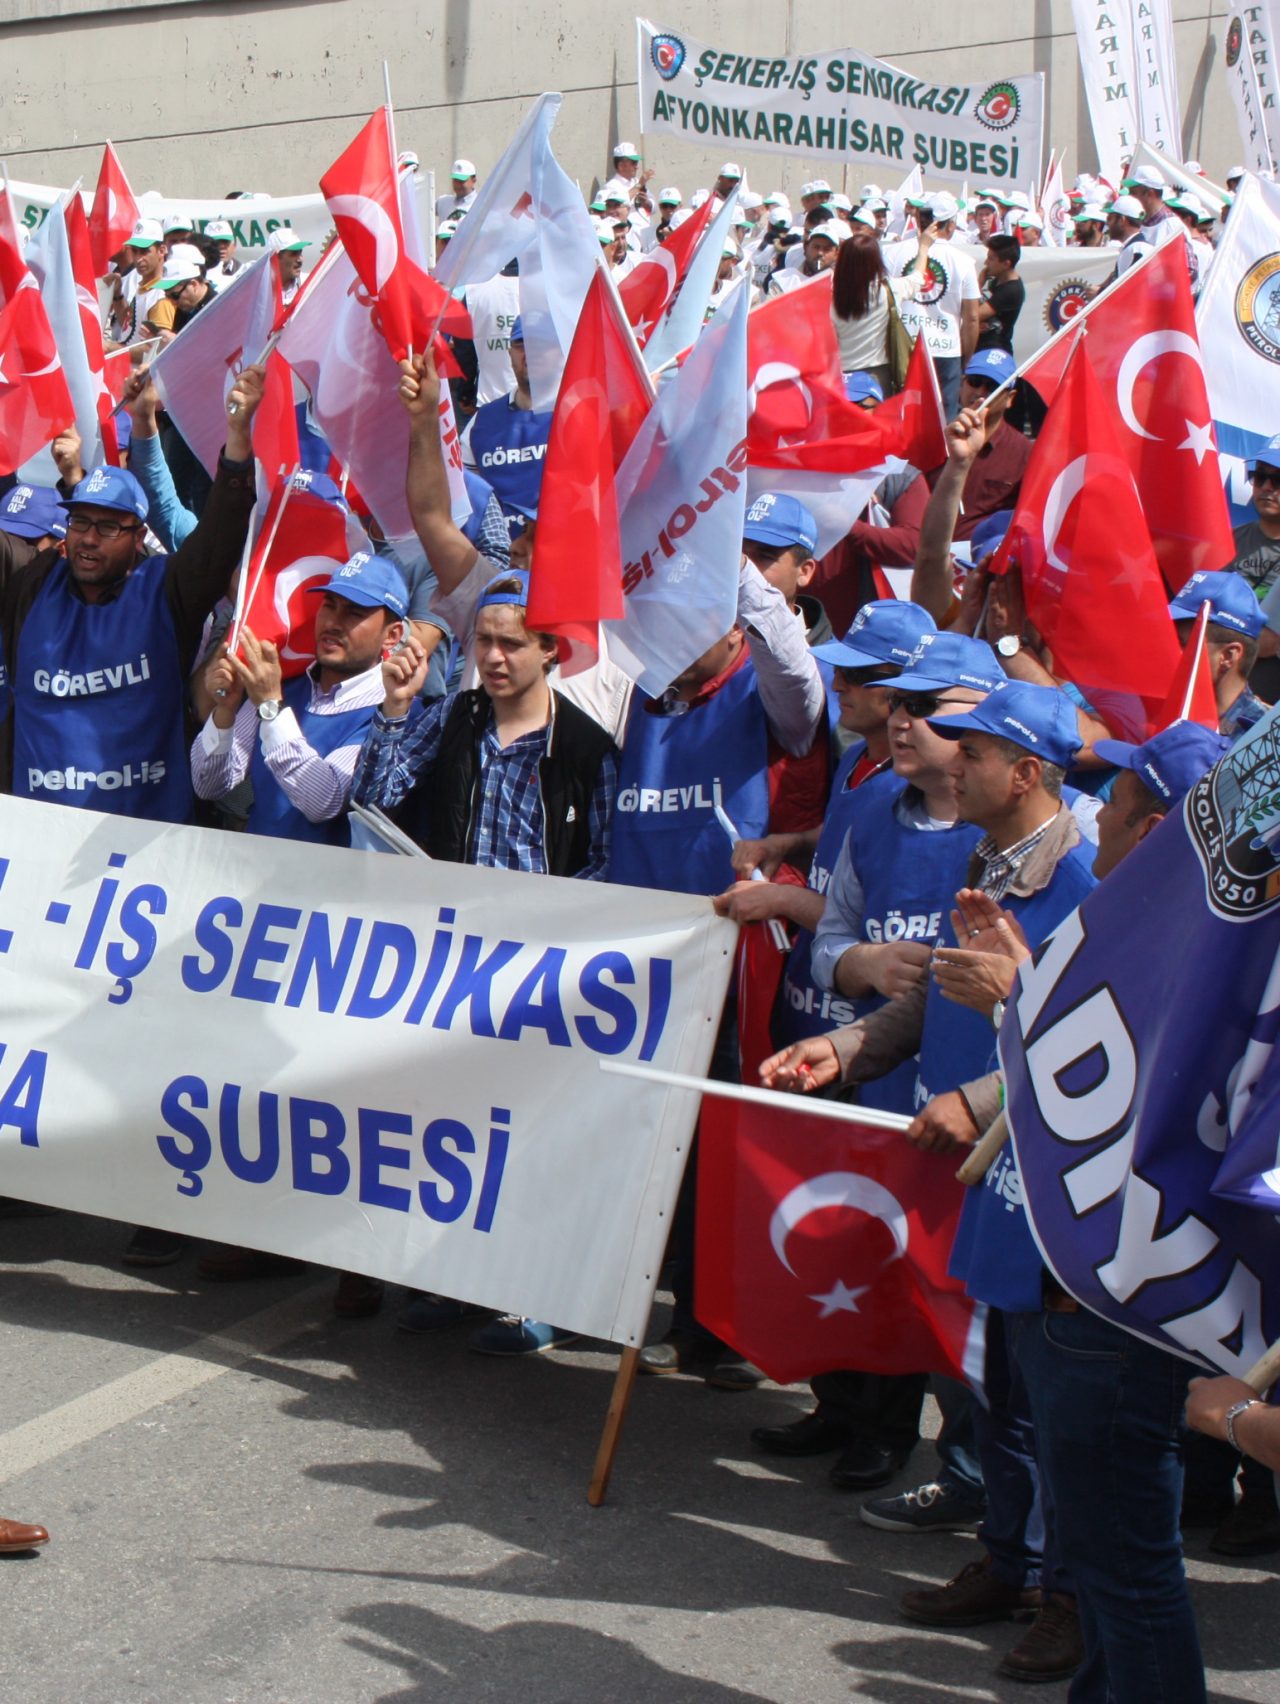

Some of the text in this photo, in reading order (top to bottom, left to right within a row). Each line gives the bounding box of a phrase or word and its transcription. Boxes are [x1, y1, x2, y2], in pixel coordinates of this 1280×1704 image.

[912, 132, 1020, 179] ŞUBESİ
[482, 444, 548, 468] GÖREV
[33, 653, 150, 697] GÖREVLİ
[28, 760, 166, 793] petrol-iş
[1213, 865, 1257, 904] 1950
[183, 895, 673, 1062] SENDİKASI
[159, 1075, 510, 1234] ŞUBESİ
